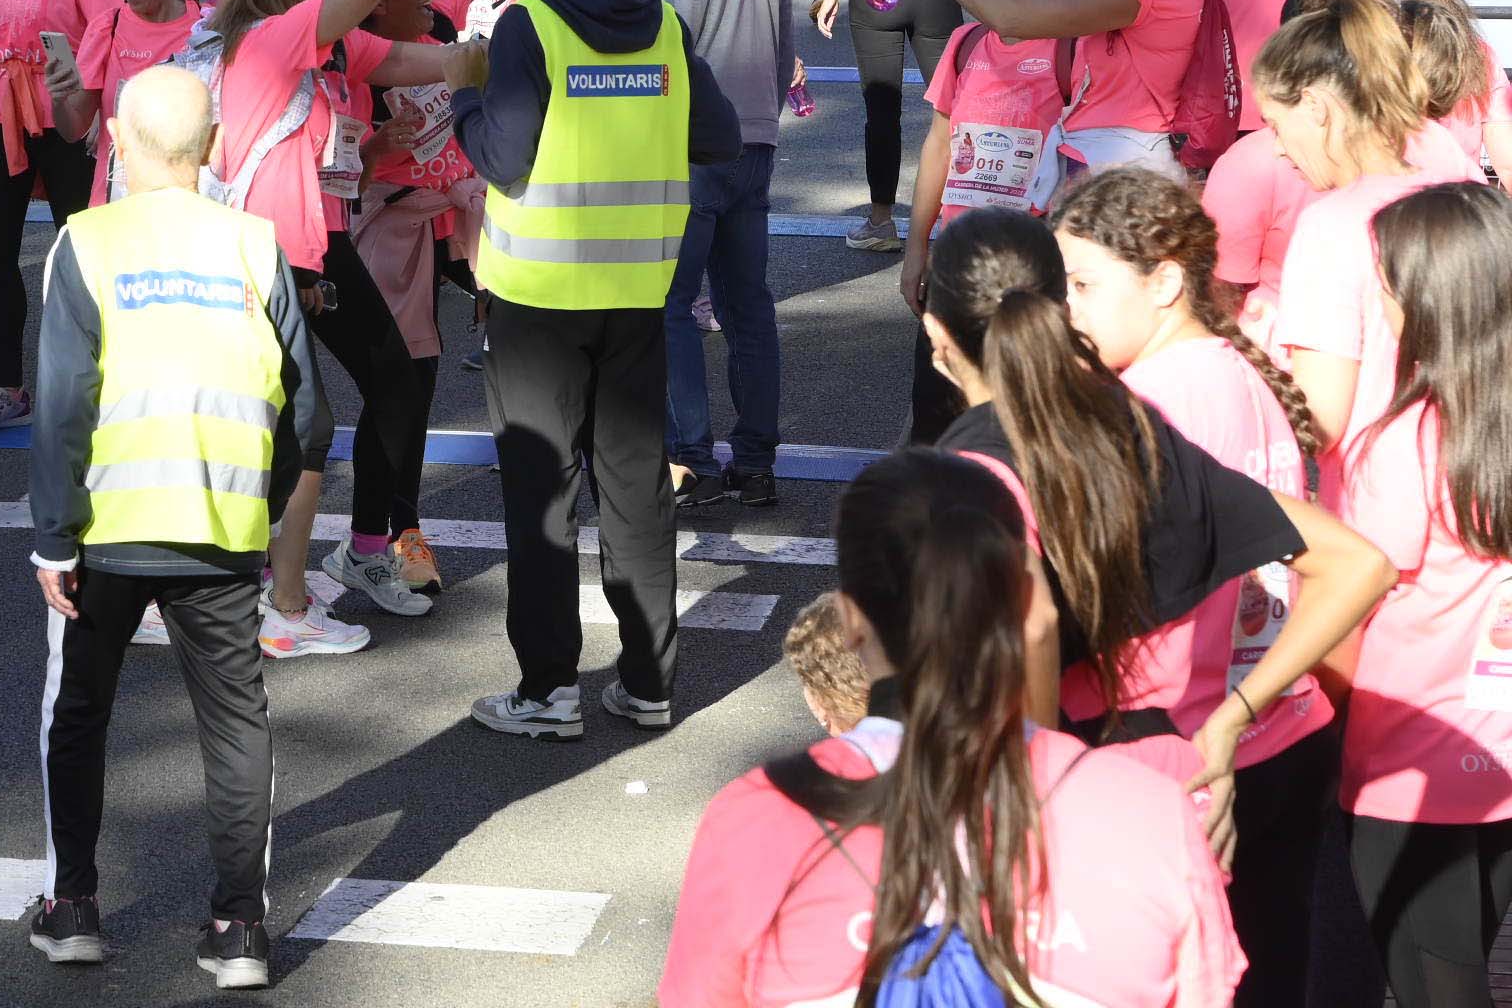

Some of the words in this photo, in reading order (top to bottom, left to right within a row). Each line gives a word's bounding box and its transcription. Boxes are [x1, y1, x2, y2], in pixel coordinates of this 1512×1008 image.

[568, 72, 662, 90] VOLUNTARIS
[424, 89, 451, 115] 016
[976, 157, 1005, 171] 016
[974, 172, 998, 182] 22669
